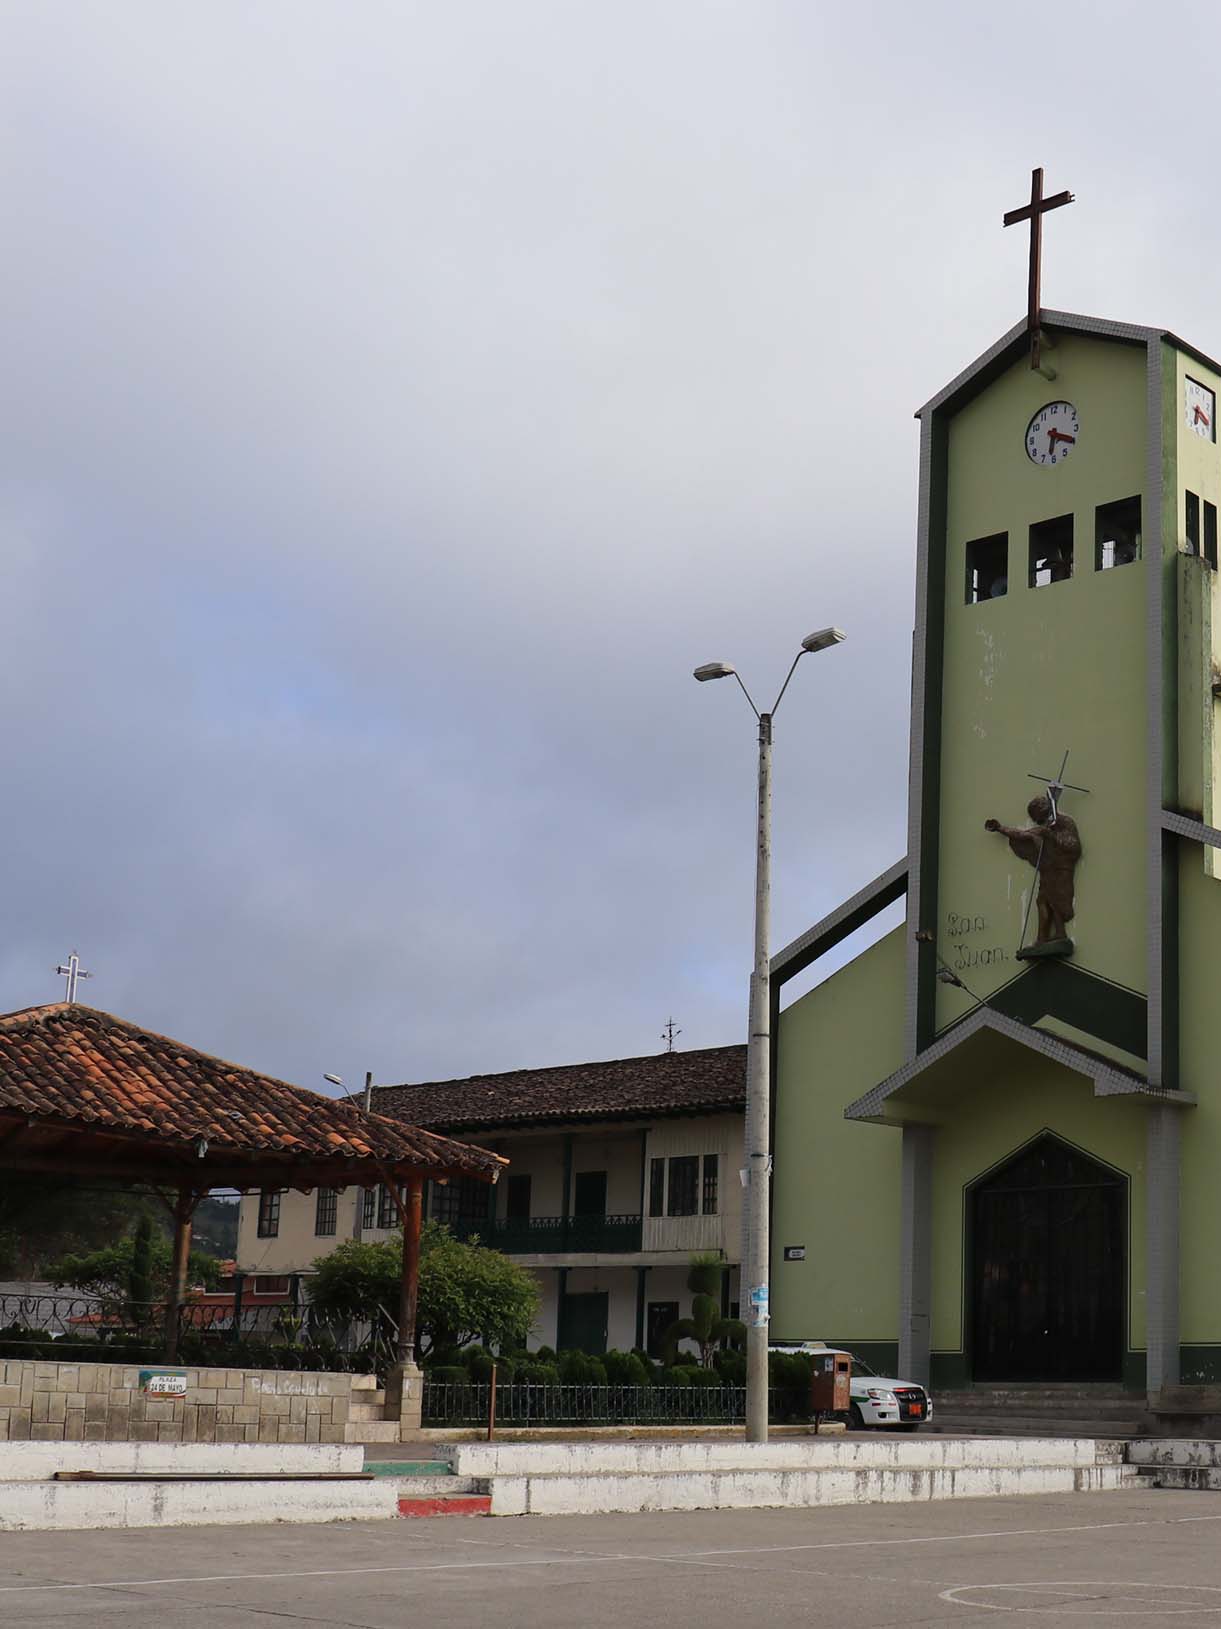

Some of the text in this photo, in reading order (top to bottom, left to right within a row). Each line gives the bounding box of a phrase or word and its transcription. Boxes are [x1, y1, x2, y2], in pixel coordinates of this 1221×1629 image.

[1050, 405, 1058, 415] 12
[1041, 412, 1047, 421] 11
[1071, 411, 1076, 421] 2
[1032, 423, 1040, 432] 10
[1073, 423, 1079, 432] 3
[1030, 436, 1035, 446] 9
[1032, 448, 1038, 457] 8
[1062, 447, 1068, 457] 5
[1041, 454, 1046, 463] 7
[1051, 454, 1057, 464] 6
[151, 1383, 183, 1392] 24 DE MAYO
